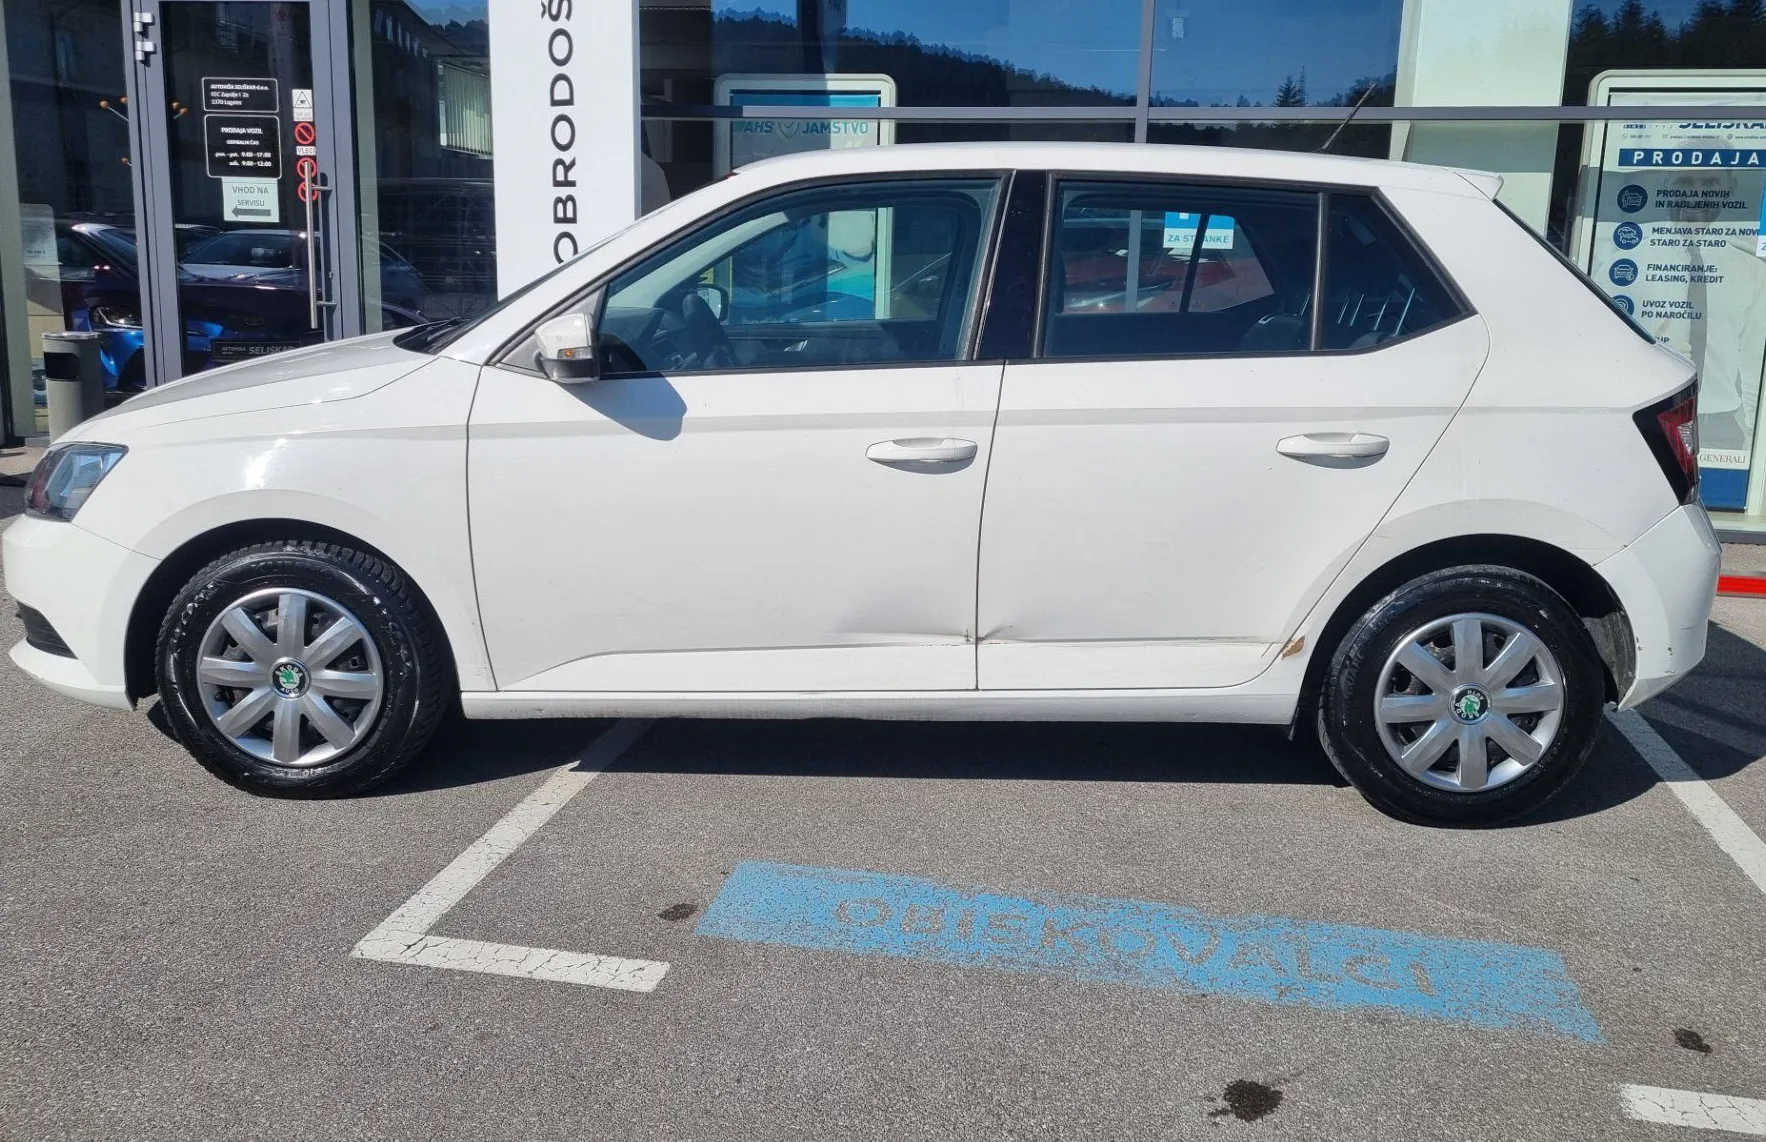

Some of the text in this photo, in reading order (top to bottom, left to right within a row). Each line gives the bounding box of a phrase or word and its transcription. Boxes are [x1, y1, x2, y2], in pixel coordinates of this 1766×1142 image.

[743, 121, 869, 135] AHS JAMSTVO
[1632, 151, 1760, 165] PRODAJA
[232, 186, 255, 194] VHOD
[1656, 189, 1730, 198] PRODAJA NOVIH
[237, 199, 265, 207] SERVISU
[1655, 200, 1748, 210] IN RABLJENIH VOZIL
[1652, 227, 1693, 236] MENJAVA
[1694, 228, 1724, 236] STARO
[1725, 228, 1737, 236] ZA
[1167, 234, 1230, 243] ZA STANKE
[1650, 238, 1727, 248] STARO ZA STARO
[1646, 263, 1718, 273] FINANCIRANJE:
[1645, 274, 1724, 284] LEASING, KREDIT
[1642, 300, 1695, 309] UVOZ VOZIL
[1641, 309, 1702, 320] PO NAROČILU
[1699, 453, 1746, 464] GENERALI
[834, 899, 1437, 996] OBISKOVALCI
